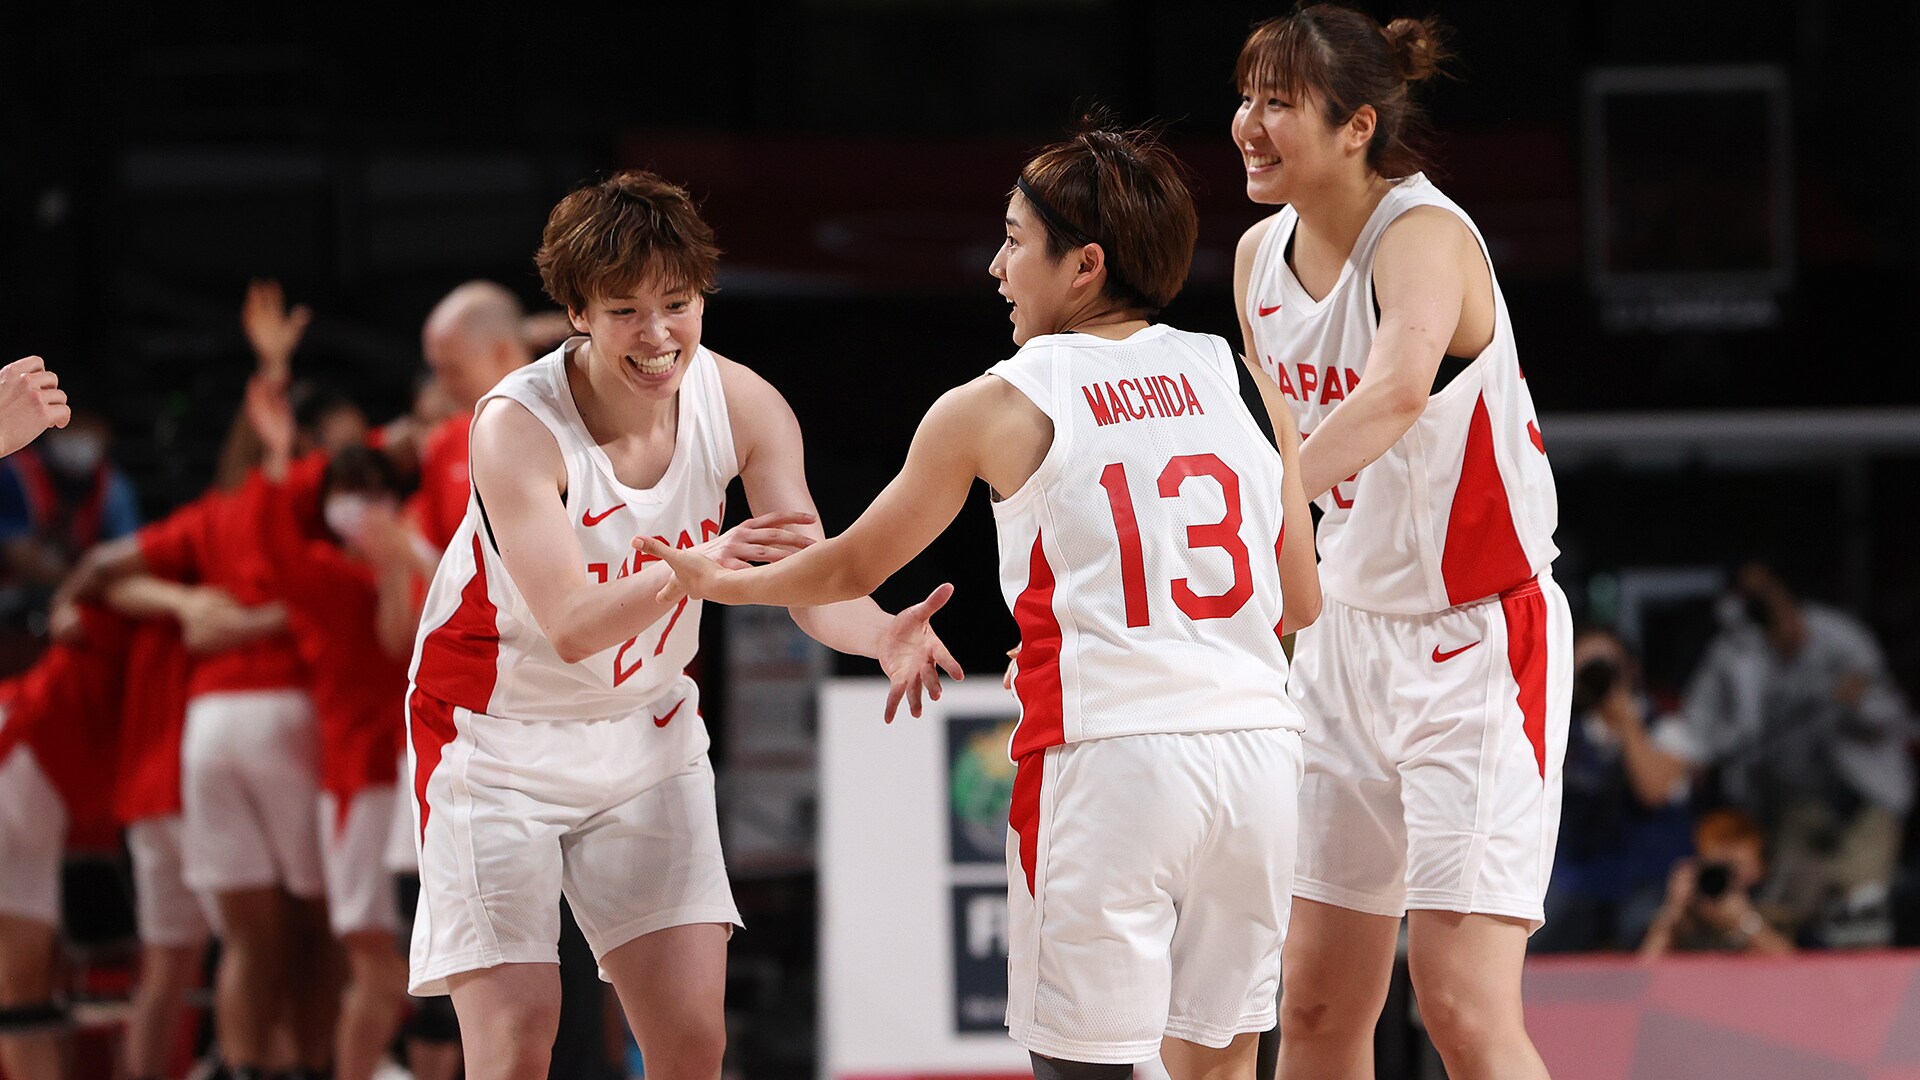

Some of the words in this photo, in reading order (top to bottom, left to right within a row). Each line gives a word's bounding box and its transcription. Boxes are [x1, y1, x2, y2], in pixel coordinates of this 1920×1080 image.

[1081, 373, 1204, 427] MACHIDA
[1267, 354, 1361, 405] APAN
[1099, 453, 1254, 628] 13
